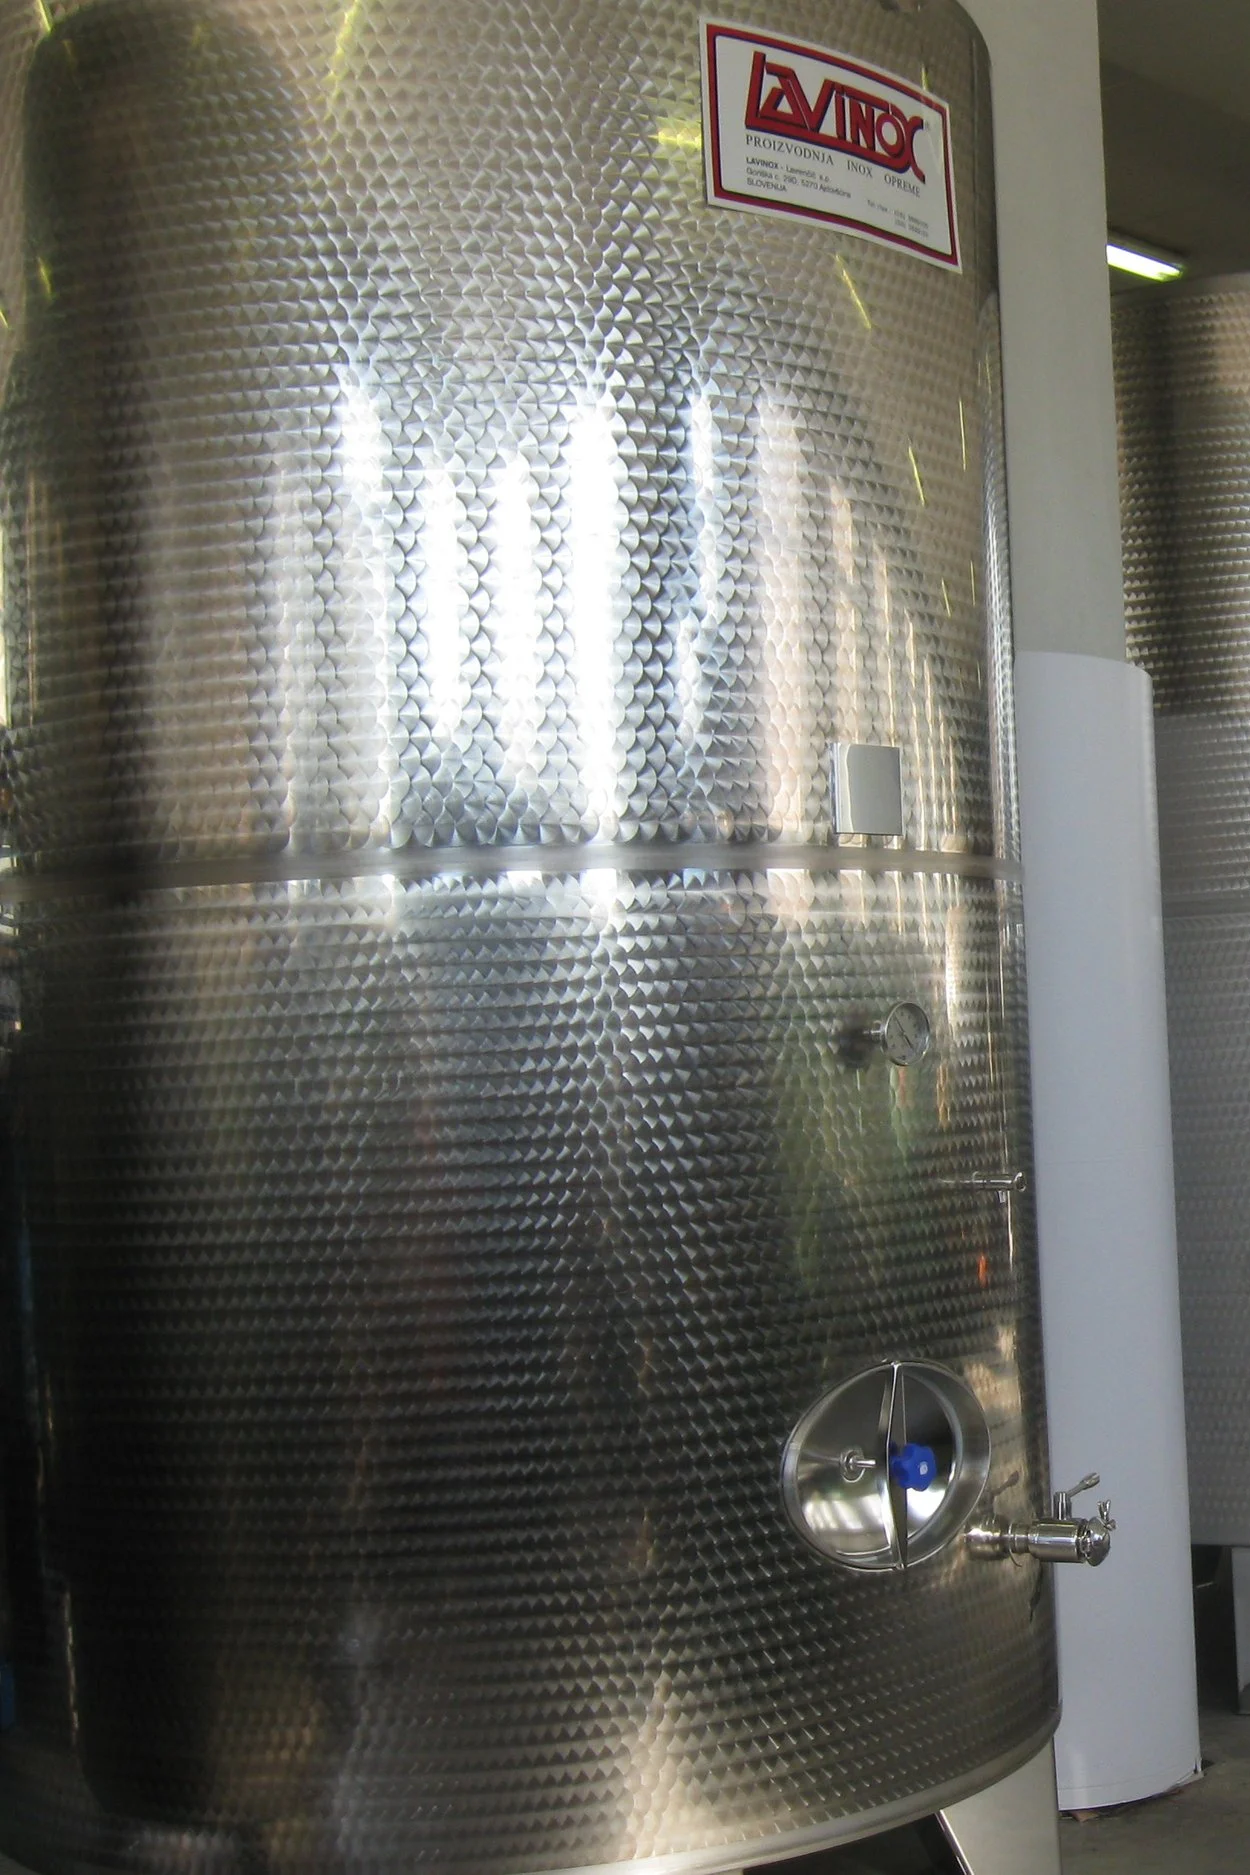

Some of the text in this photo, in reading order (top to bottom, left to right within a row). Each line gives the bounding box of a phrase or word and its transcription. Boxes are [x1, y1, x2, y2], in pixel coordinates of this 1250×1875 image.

[745, 51, 926, 184] LAVINOX
[745, 134, 921, 198] PROIZVODNJA INOX OPREME
[746, 157, 779, 169] LAVINOX
[747, 177, 787, 192] SLOVENIJA
